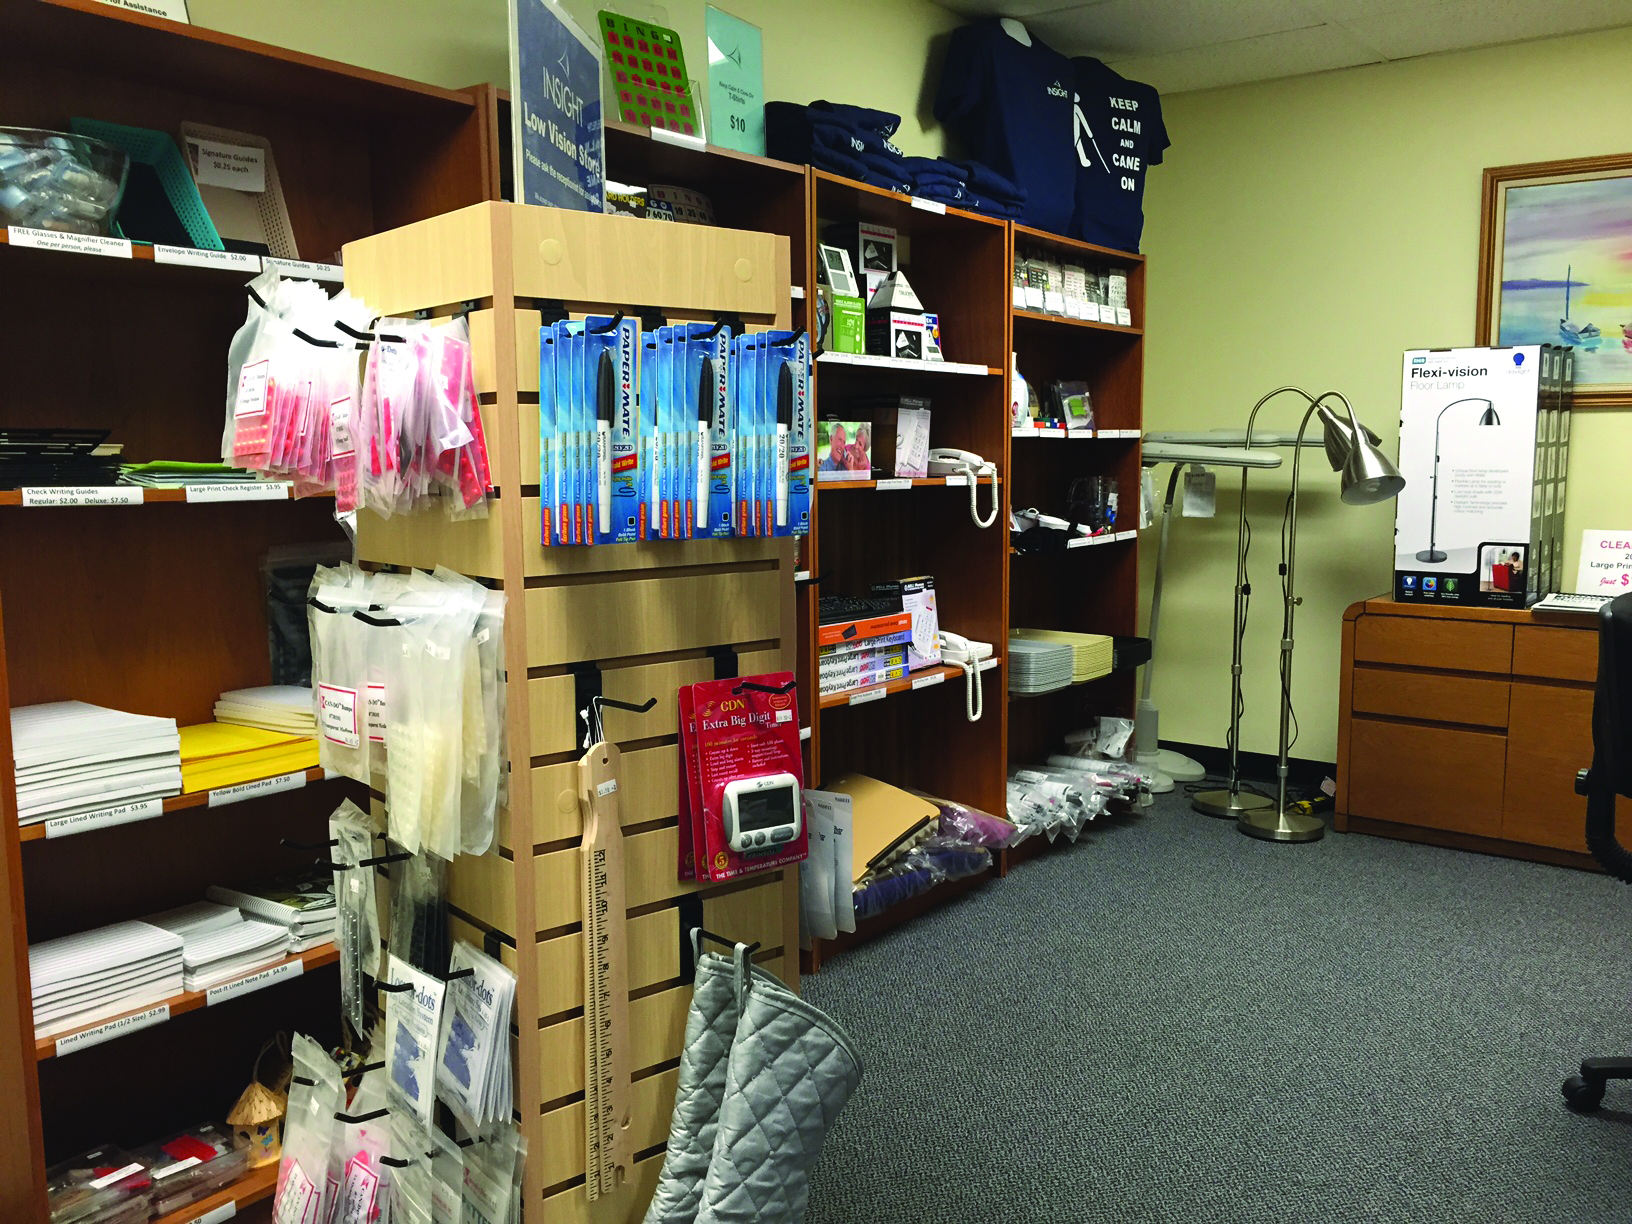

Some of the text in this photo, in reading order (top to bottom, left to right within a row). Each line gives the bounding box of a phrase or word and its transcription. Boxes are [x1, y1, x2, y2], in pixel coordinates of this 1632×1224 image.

[124, 0, 168, 16] Assistance
[542, 66, 584, 128] INSIGHT
[1108, 96, 1139, 112] KEEP
[730, 114, 746, 133] $10
[1111, 116, 1141, 135] CALM
[524, 101, 546, 138] Low
[548, 119, 578, 162] Vision
[578, 144, 601, 178] Store
[1120, 138, 1134, 149] AND
[202, 148, 258, 163] Signature Guides
[526, 148, 540, 168] Please
[541, 161, 550, 174] ask
[1112, 153, 1140, 172] CANE
[213, 161, 230, 171] $0.25
[1120, 176, 1135, 192] ON
[618, 194, 645, 207] HOLDERS
[653, 211, 672, 221] 60 70
[32, 230, 58, 239] Glasses
[66, 234, 98, 244] Magnifier
[100, 238, 124, 247] Cleaner
[158, 246, 185, 255] Envelope
[187, 250, 209, 258] Writing
[1411, 366, 1488, 378] Flexi-vision
[622, 326, 631, 438] PAPER MATE
[718, 332, 727, 438] PAPER MATE
[1410, 380, 1464, 390] Floor Lamp
[797, 395, 805, 440] MATE
[1600, 540, 1632, 550] CLEA
[1590, 562, 1614, 570] Large
[1599, 577, 1617, 586] Just
[864, 633, 904, 648] Large Print Keyboard
[820, 653, 859, 666] Large Print Keyboar
[836, 665, 858, 676] Large Print
[836, 679, 858, 690] Large Print
[720, 699, 745, 712] CDN
[702, 716, 729, 731] Extra
[731, 714, 746, 729] Big
[749, 711, 771, 726] Digit
[212, 776, 291, 797] Yellow Bold Lined Pad $7.50
[50, 820, 68, 829] Large
[70, 814, 87, 824] Lined
[89, 810, 113, 821] Writing
[130, 803, 148, 812] $3.95
[597, 850, 606, 862] 12
[719, 856, 724, 865] 5
[726, 870, 738, 878] TIME
[744, 860, 778, 872] TEMPERATURE
[600, 873, 607, 885] 11
[601, 900, 608, 913] 10
[602, 934, 608, 944] 9
[229, 981, 244, 990] Lined
[245, 977, 258, 985] Note
[259, 972, 270, 980] Pad
[273, 966, 288, 975] $4.99
[452, 956, 493, 1006] Lor-dots
[390, 967, 436, 1011] Loor-dots
[60, 1007, 166, 1046] Lined Writing Pad (1/2 Size) $2.99
[606, 1050, 612, 1058] 5
